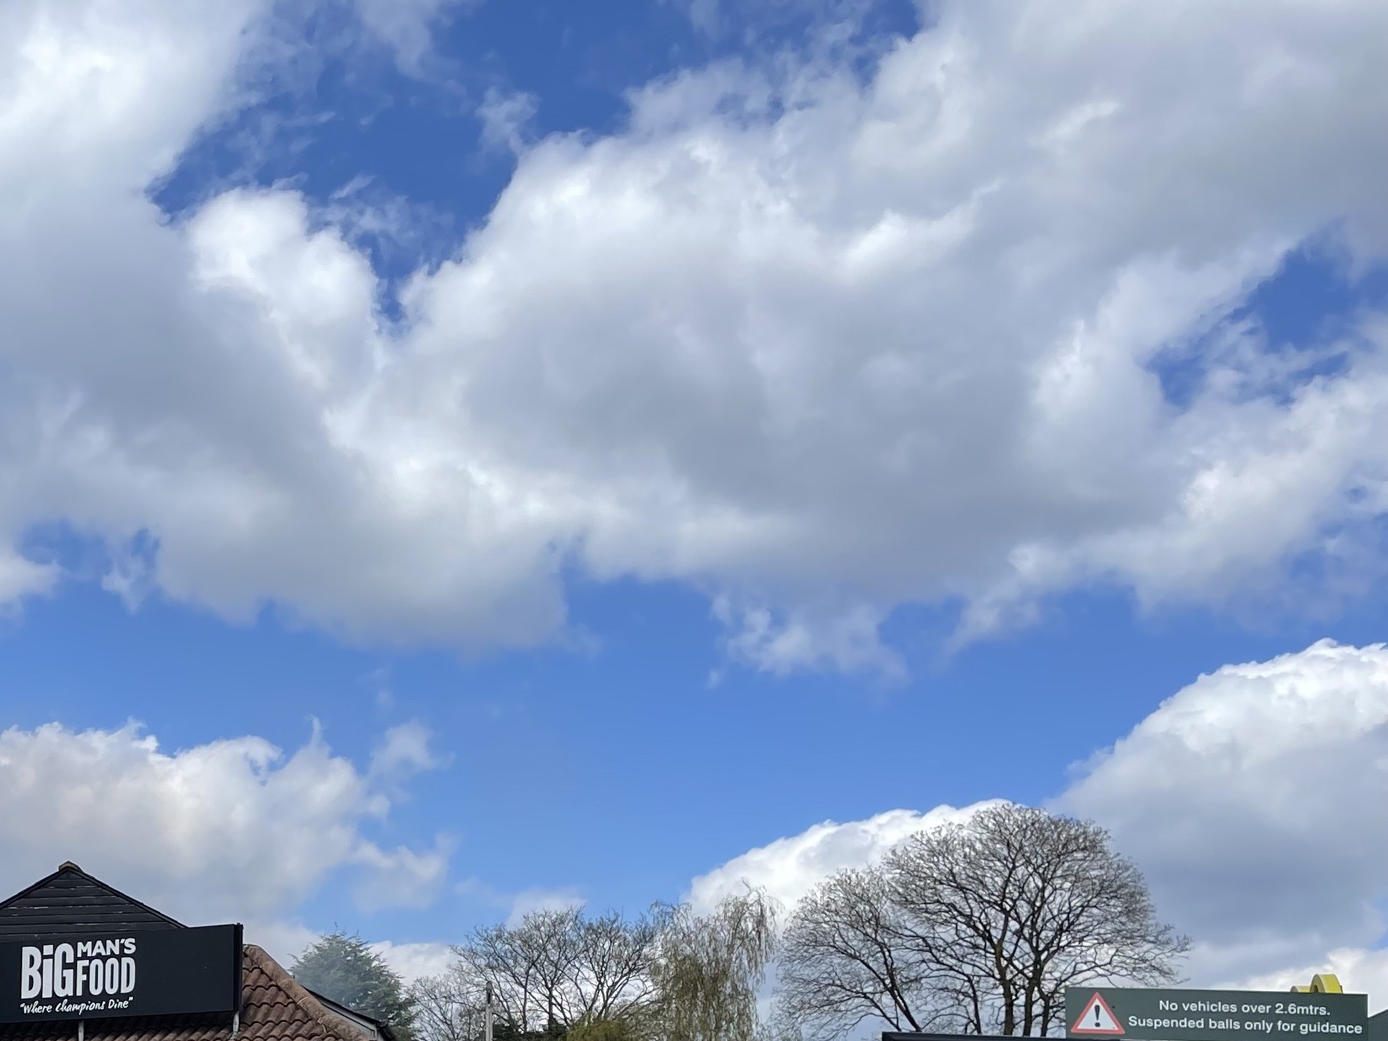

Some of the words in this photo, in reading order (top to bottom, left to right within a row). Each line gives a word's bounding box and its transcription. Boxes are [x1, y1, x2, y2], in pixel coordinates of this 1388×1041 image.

[77, 938, 136, 957] MAN'S
[76, 957, 135, 996] FOOD
[1159, 1000, 1178, 1011] No
[1182, 1001, 1237, 1013] vehicles
[1242, 1003, 1270, 1014] over
[1275, 1003, 1331, 1015] 2.6mtrs.
[1128, 1016, 1204, 1030] Suspended
[1209, 1018, 1240, 1030] balls
[1244, 1019, 1273, 1033] only
[1277, 1020, 1296, 1032] for
[1300, 1021, 1363, 1034] guidance
